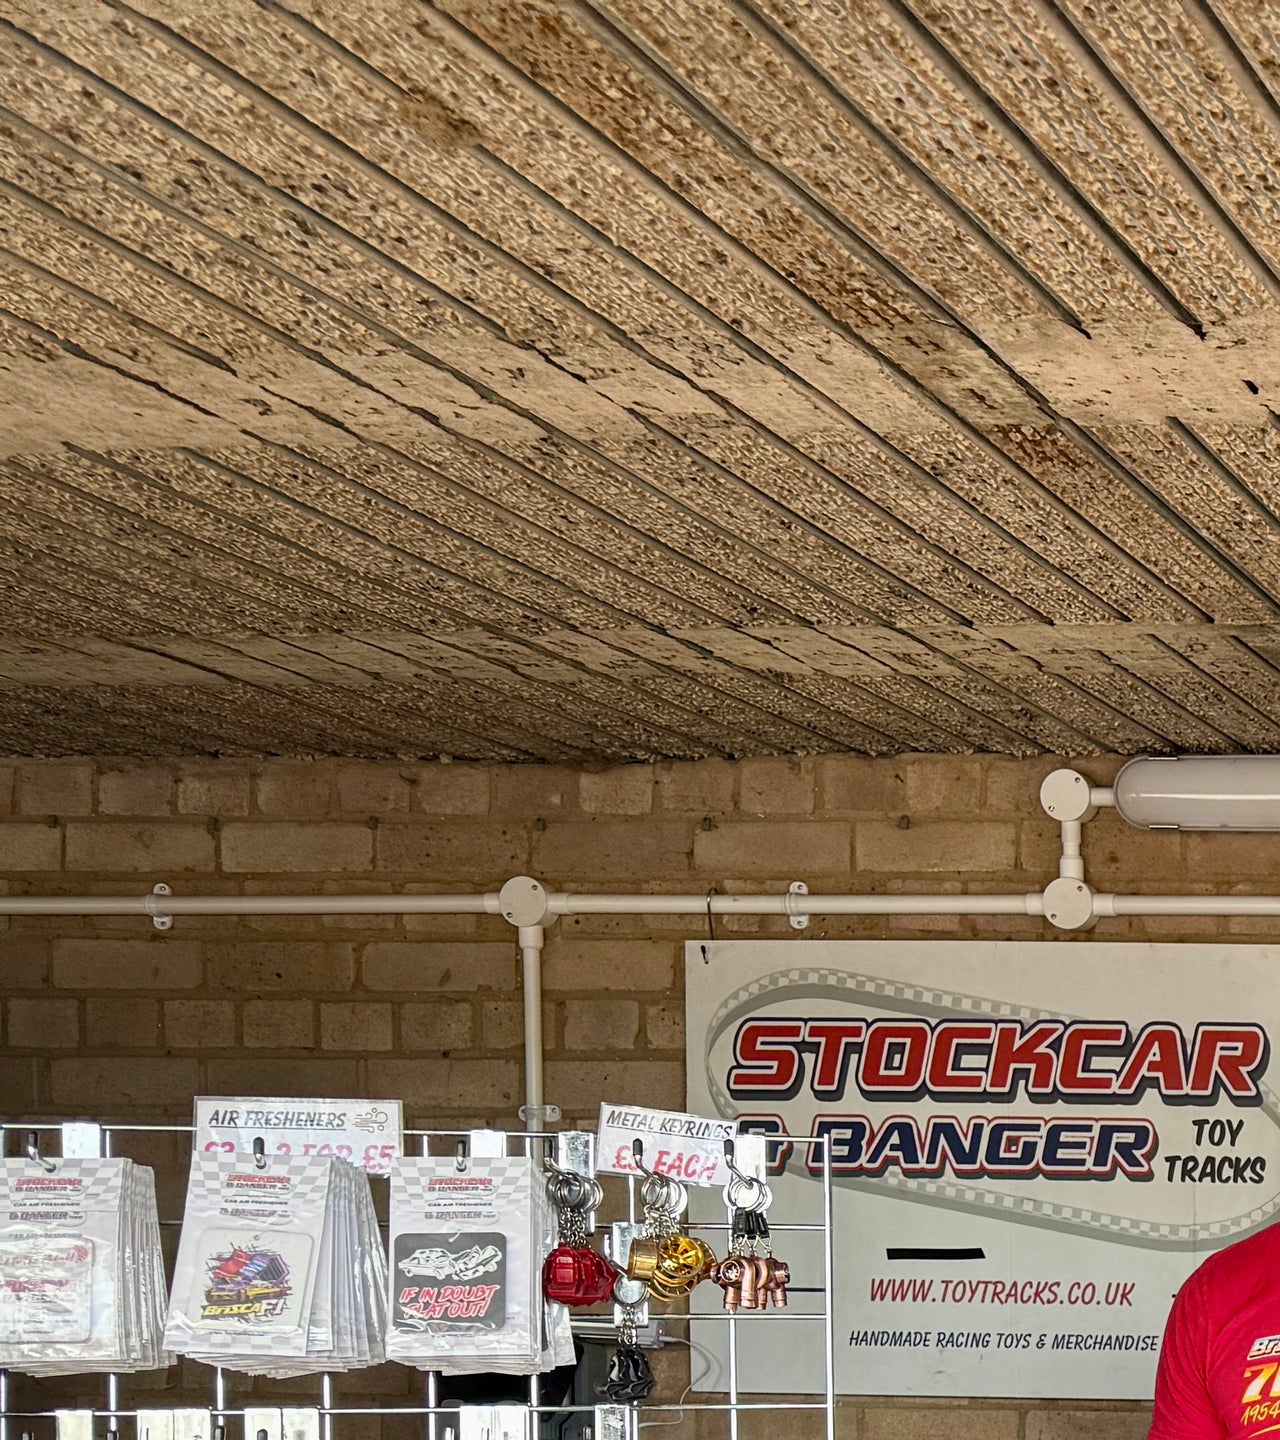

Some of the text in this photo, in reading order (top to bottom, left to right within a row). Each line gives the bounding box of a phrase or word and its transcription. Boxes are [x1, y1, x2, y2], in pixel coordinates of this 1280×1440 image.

[728, 1018, 1268, 1105] STOCKCAR
[208, 1110, 347, 1129] AIR FRESHENERS
[606, 1109, 734, 1140] METAL KEYRINGS
[1193, 1117, 1244, 1147] TOY
[809, 1115, 1158, 1182] BANGER
[653, 1150, 719, 1181] EACH
[1165, 1154, 1266, 1185] TRACKS
[441, 1285, 499, 1302] DOUBT
[869, 1276, 1135, 1307] WWW.TOYTRACKS.CO.UK
[848, 1330, 1159, 1351] HANDMADE RACING TOYS & MERCHANDISE
